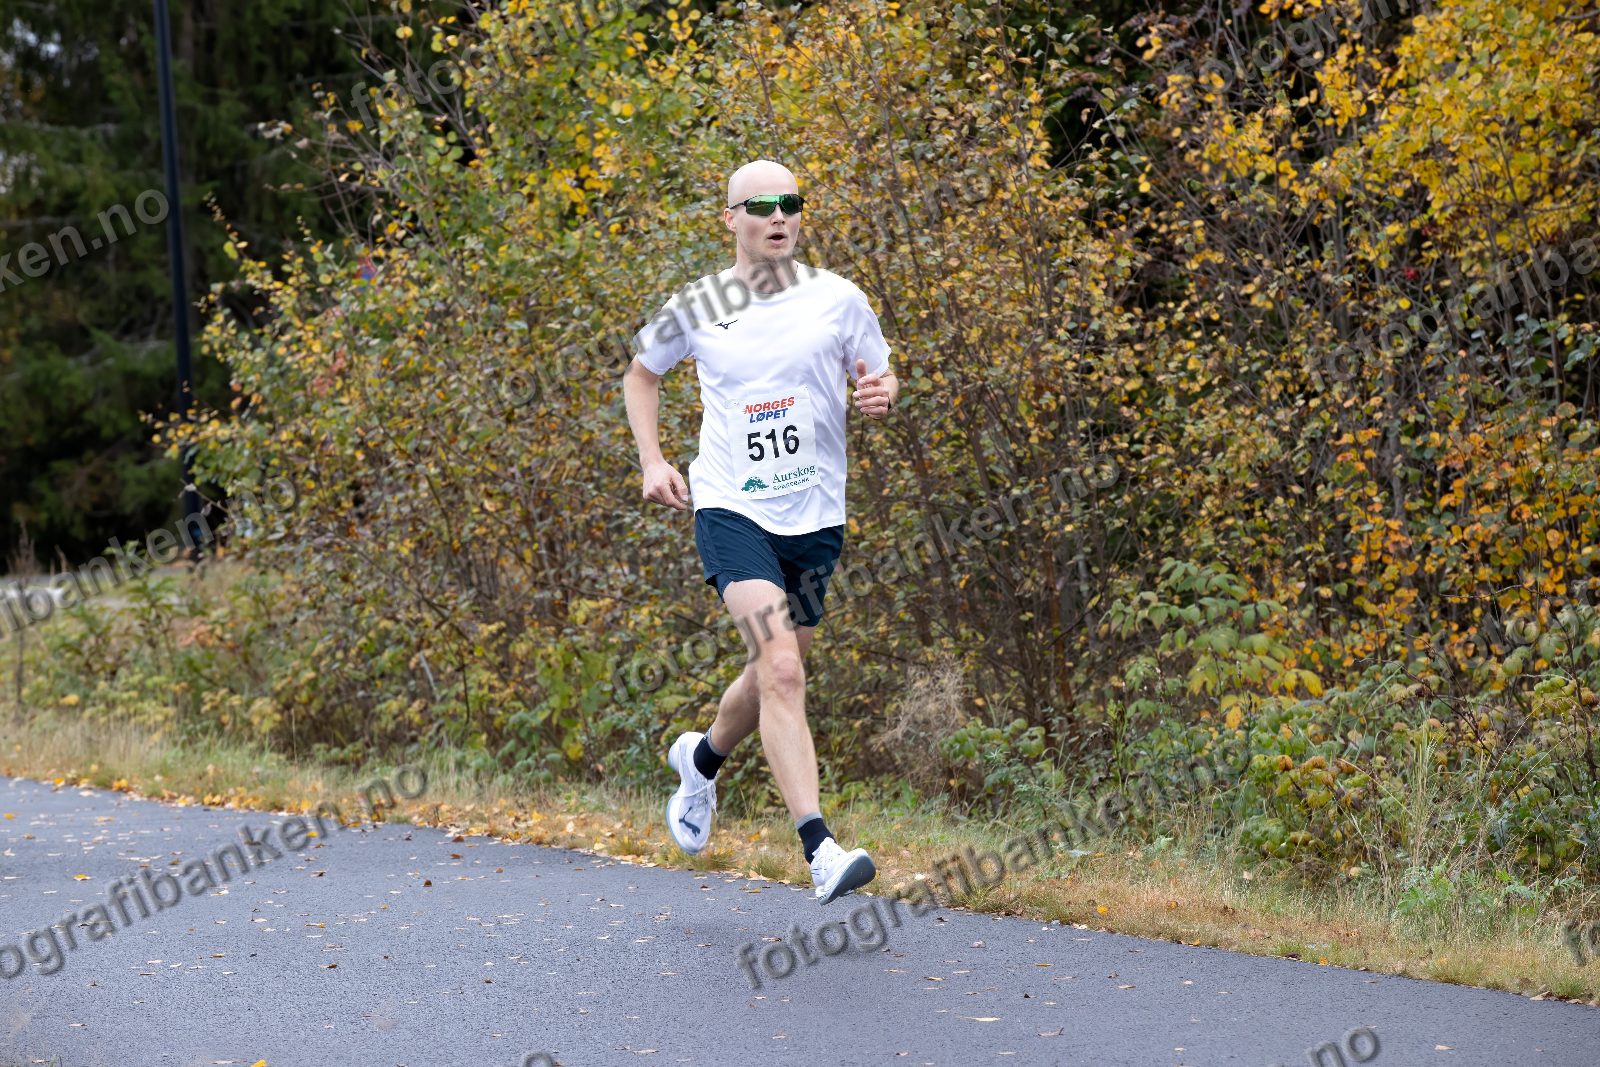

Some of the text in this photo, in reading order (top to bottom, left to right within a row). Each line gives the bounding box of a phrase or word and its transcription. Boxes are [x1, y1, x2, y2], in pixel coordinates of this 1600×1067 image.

[741, 396, 795, 414] NORGES
[749, 408, 788, 424] LØPET
[747, 425, 800, 462] 516
[772, 465, 816, 484] Aurskog
